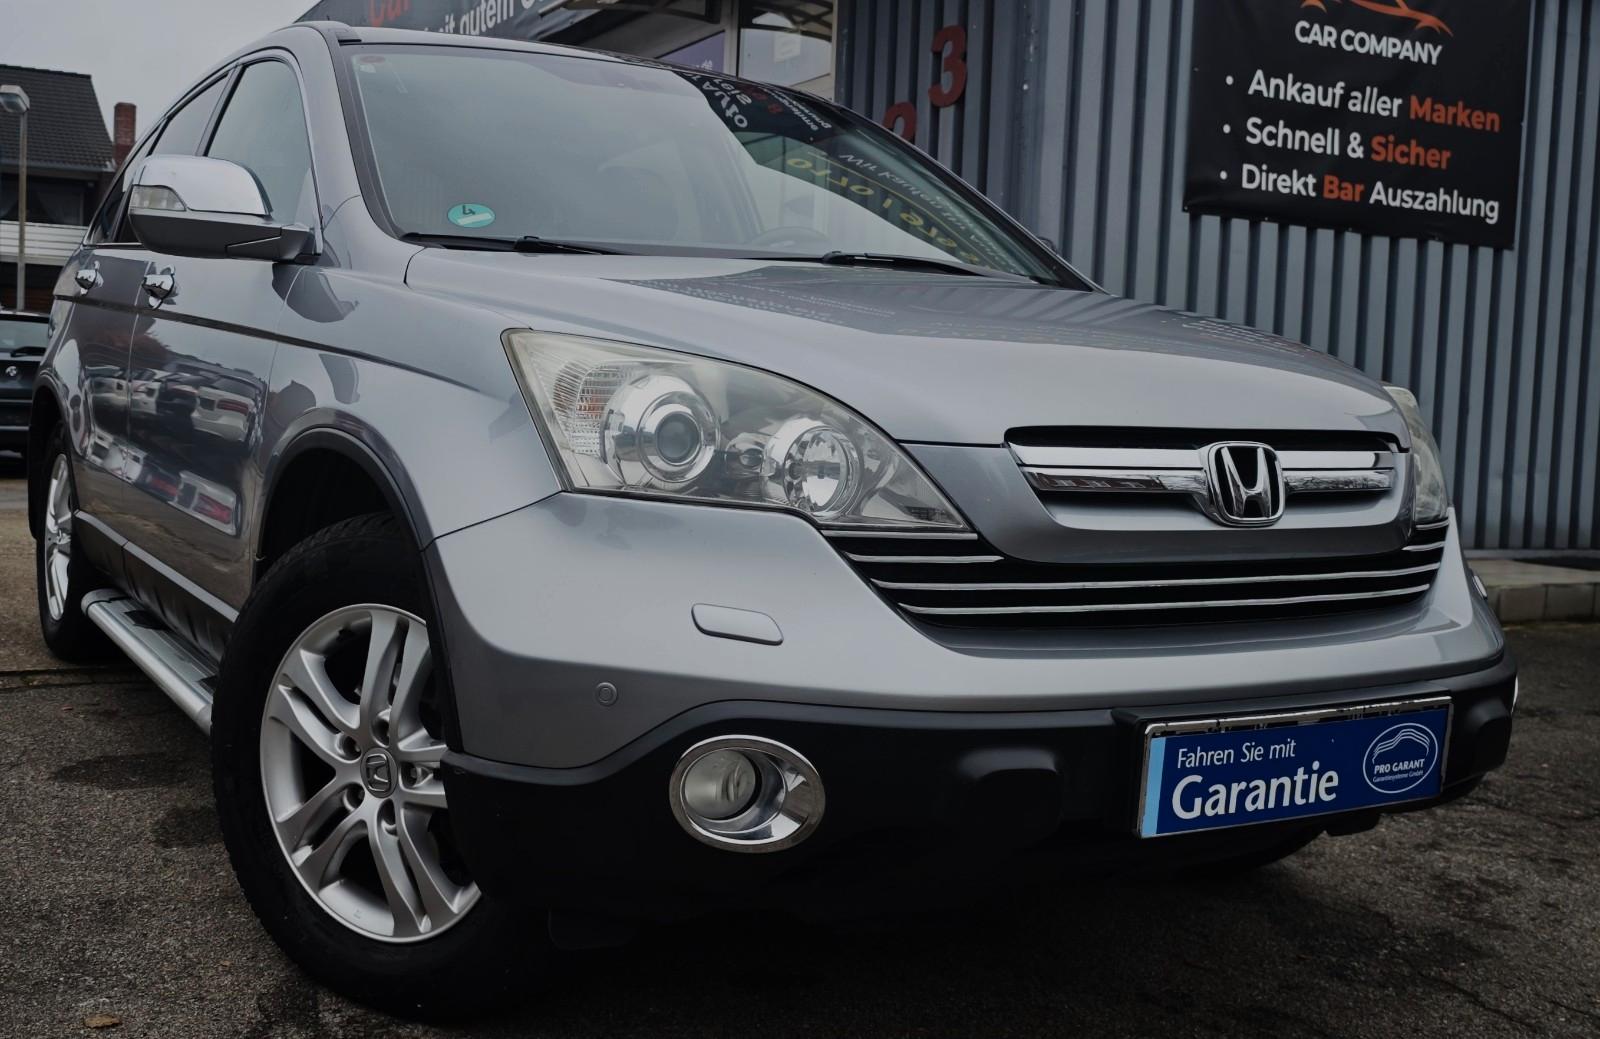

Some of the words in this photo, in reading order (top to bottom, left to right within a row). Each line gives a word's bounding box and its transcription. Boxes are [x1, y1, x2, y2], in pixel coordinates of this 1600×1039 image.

[928, 24, 968, 108] 3
[1294, 20, 1337, 48] CAR
[1340, 29, 1443, 65] COMPANY
[1247, 69, 1345, 109] Ankauf
[1347, 86, 1403, 118] aller
[1409, 95, 1501, 132] Marken
[1245, 117, 1340, 156] Schnell
[1347, 132, 1364, 159] &
[1370, 135, 1453, 170] Sicher
[462, 204, 476, 215] 4
[1241, 163, 1317, 198] Direkt
[1322, 174, 1366, 202] Bar
[1368, 181, 1500, 225] Auszahlung
[1177, 746, 1235, 769] Fahren
[1241, 742, 1264, 763] Sie
[1269, 738, 1297, 760] mit
[1374, 764, 1390, 775] PRO
[1392, 758, 1426, 772] GARANT
[1171, 760, 1339, 820] Garantie
